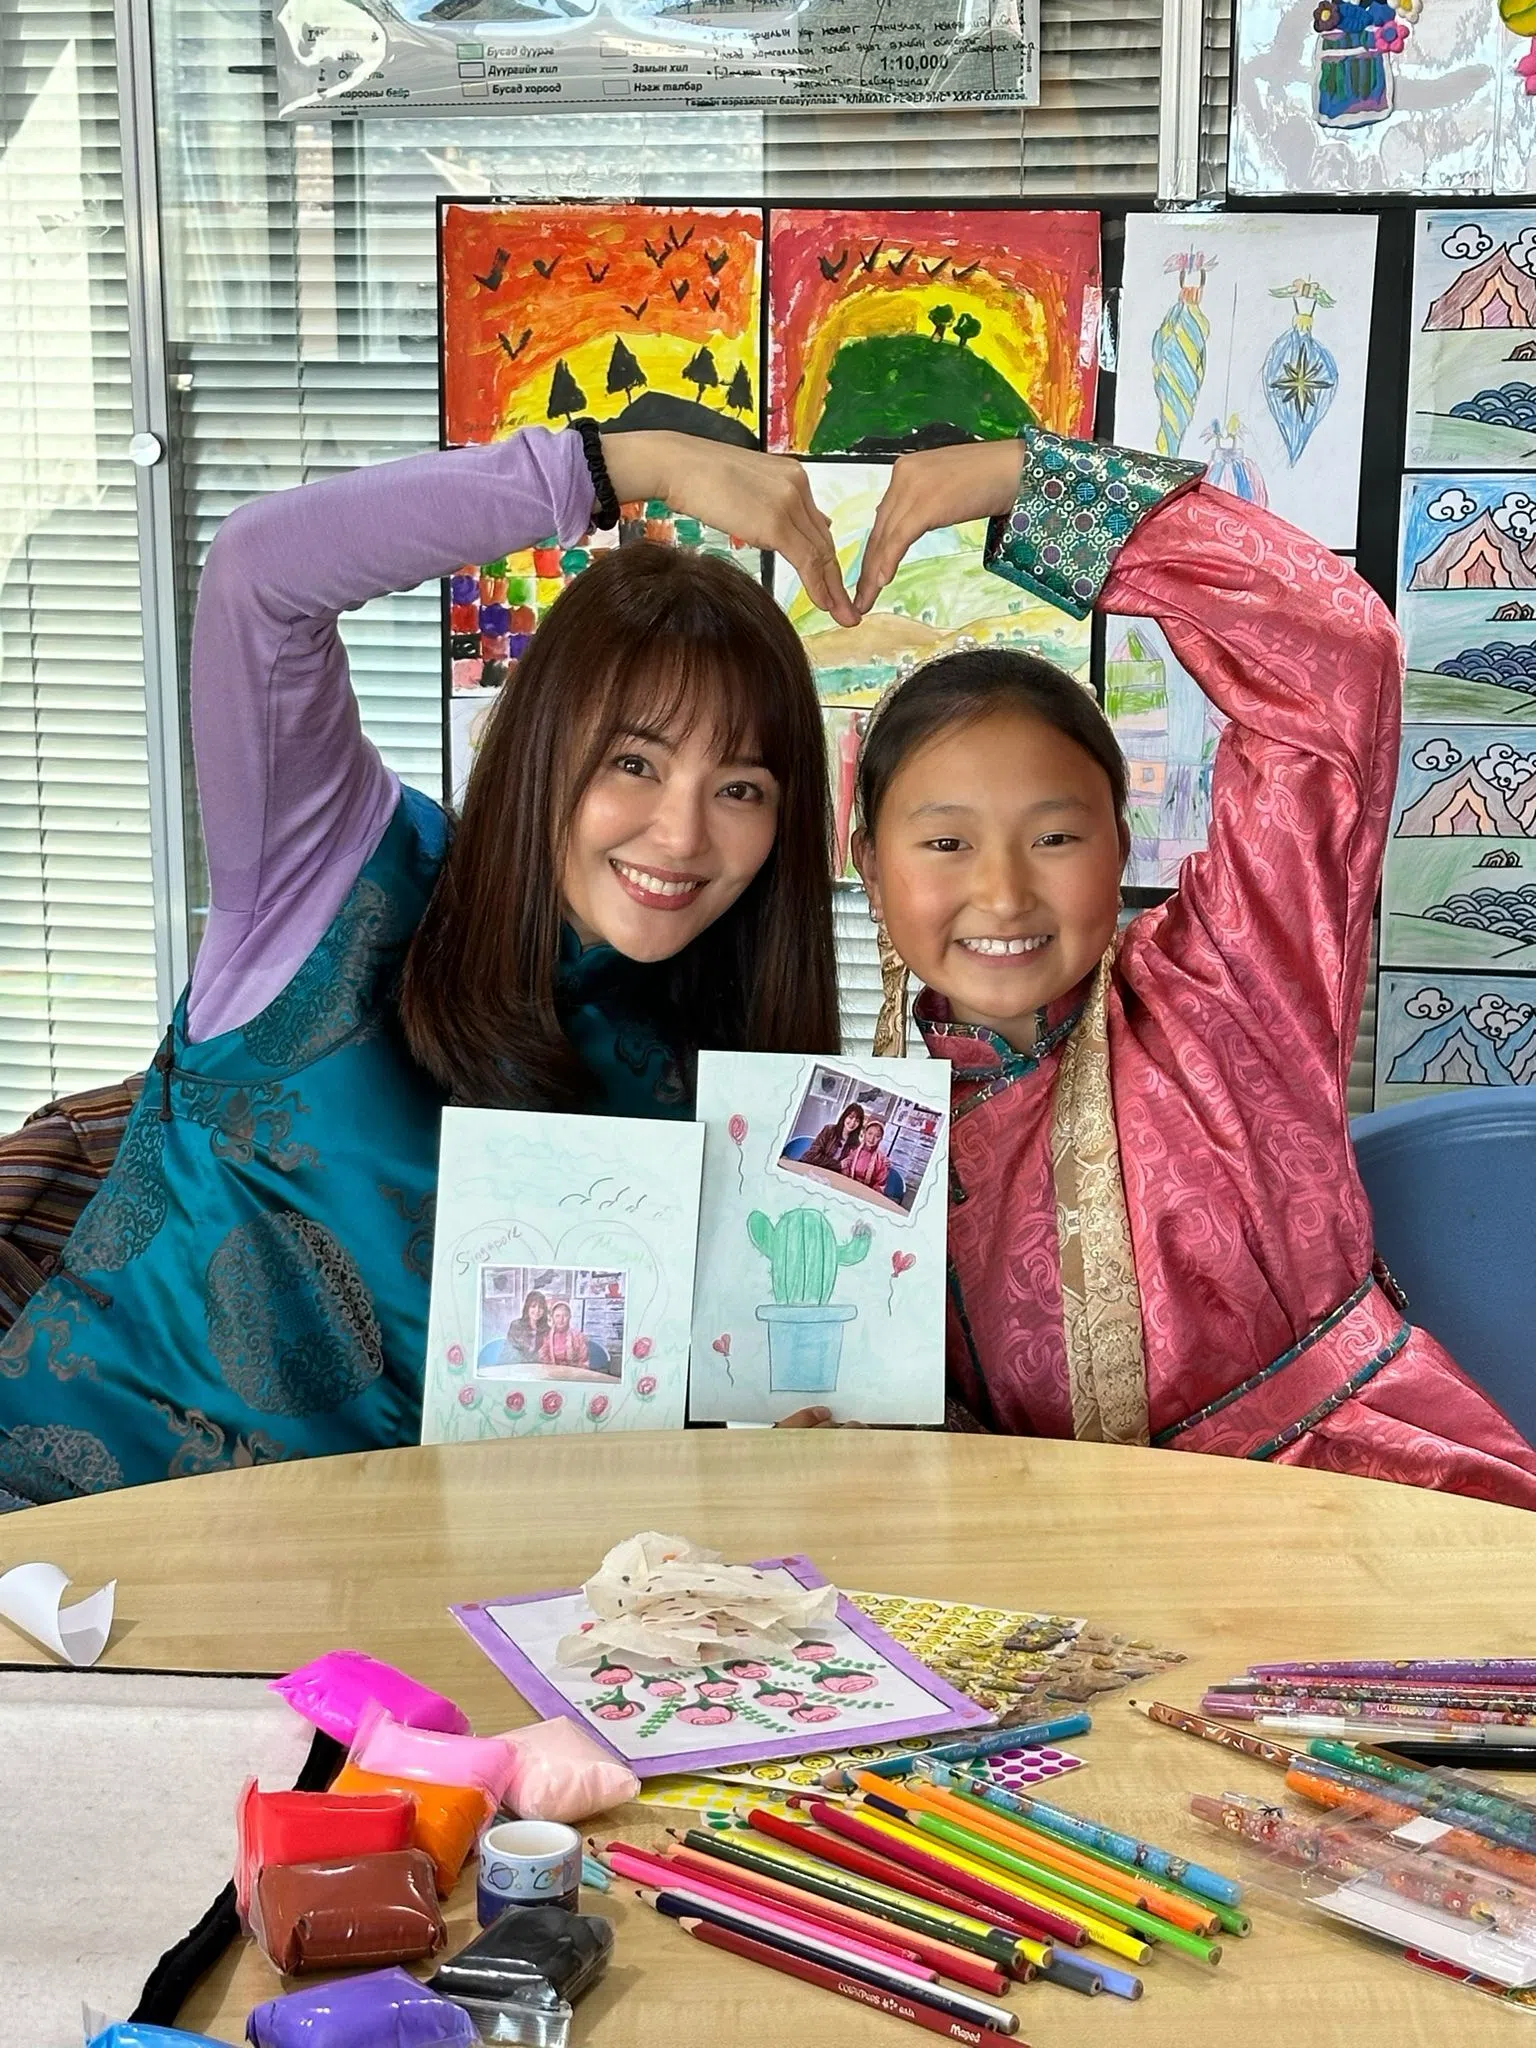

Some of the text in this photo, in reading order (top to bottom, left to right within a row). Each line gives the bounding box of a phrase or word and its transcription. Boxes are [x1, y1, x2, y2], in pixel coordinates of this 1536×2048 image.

[486, 46, 518, 58] Бусад
[632, 63, 689, 73] Замын хил
[880, 54, 949, 72] 1:10,000
[538, 65, 559, 75] хил
[492, 82, 562, 97] Бусад хороод
[633, 81, 703, 93] Нэгж талбар
[950, 2023, 982, 2044] Maped
